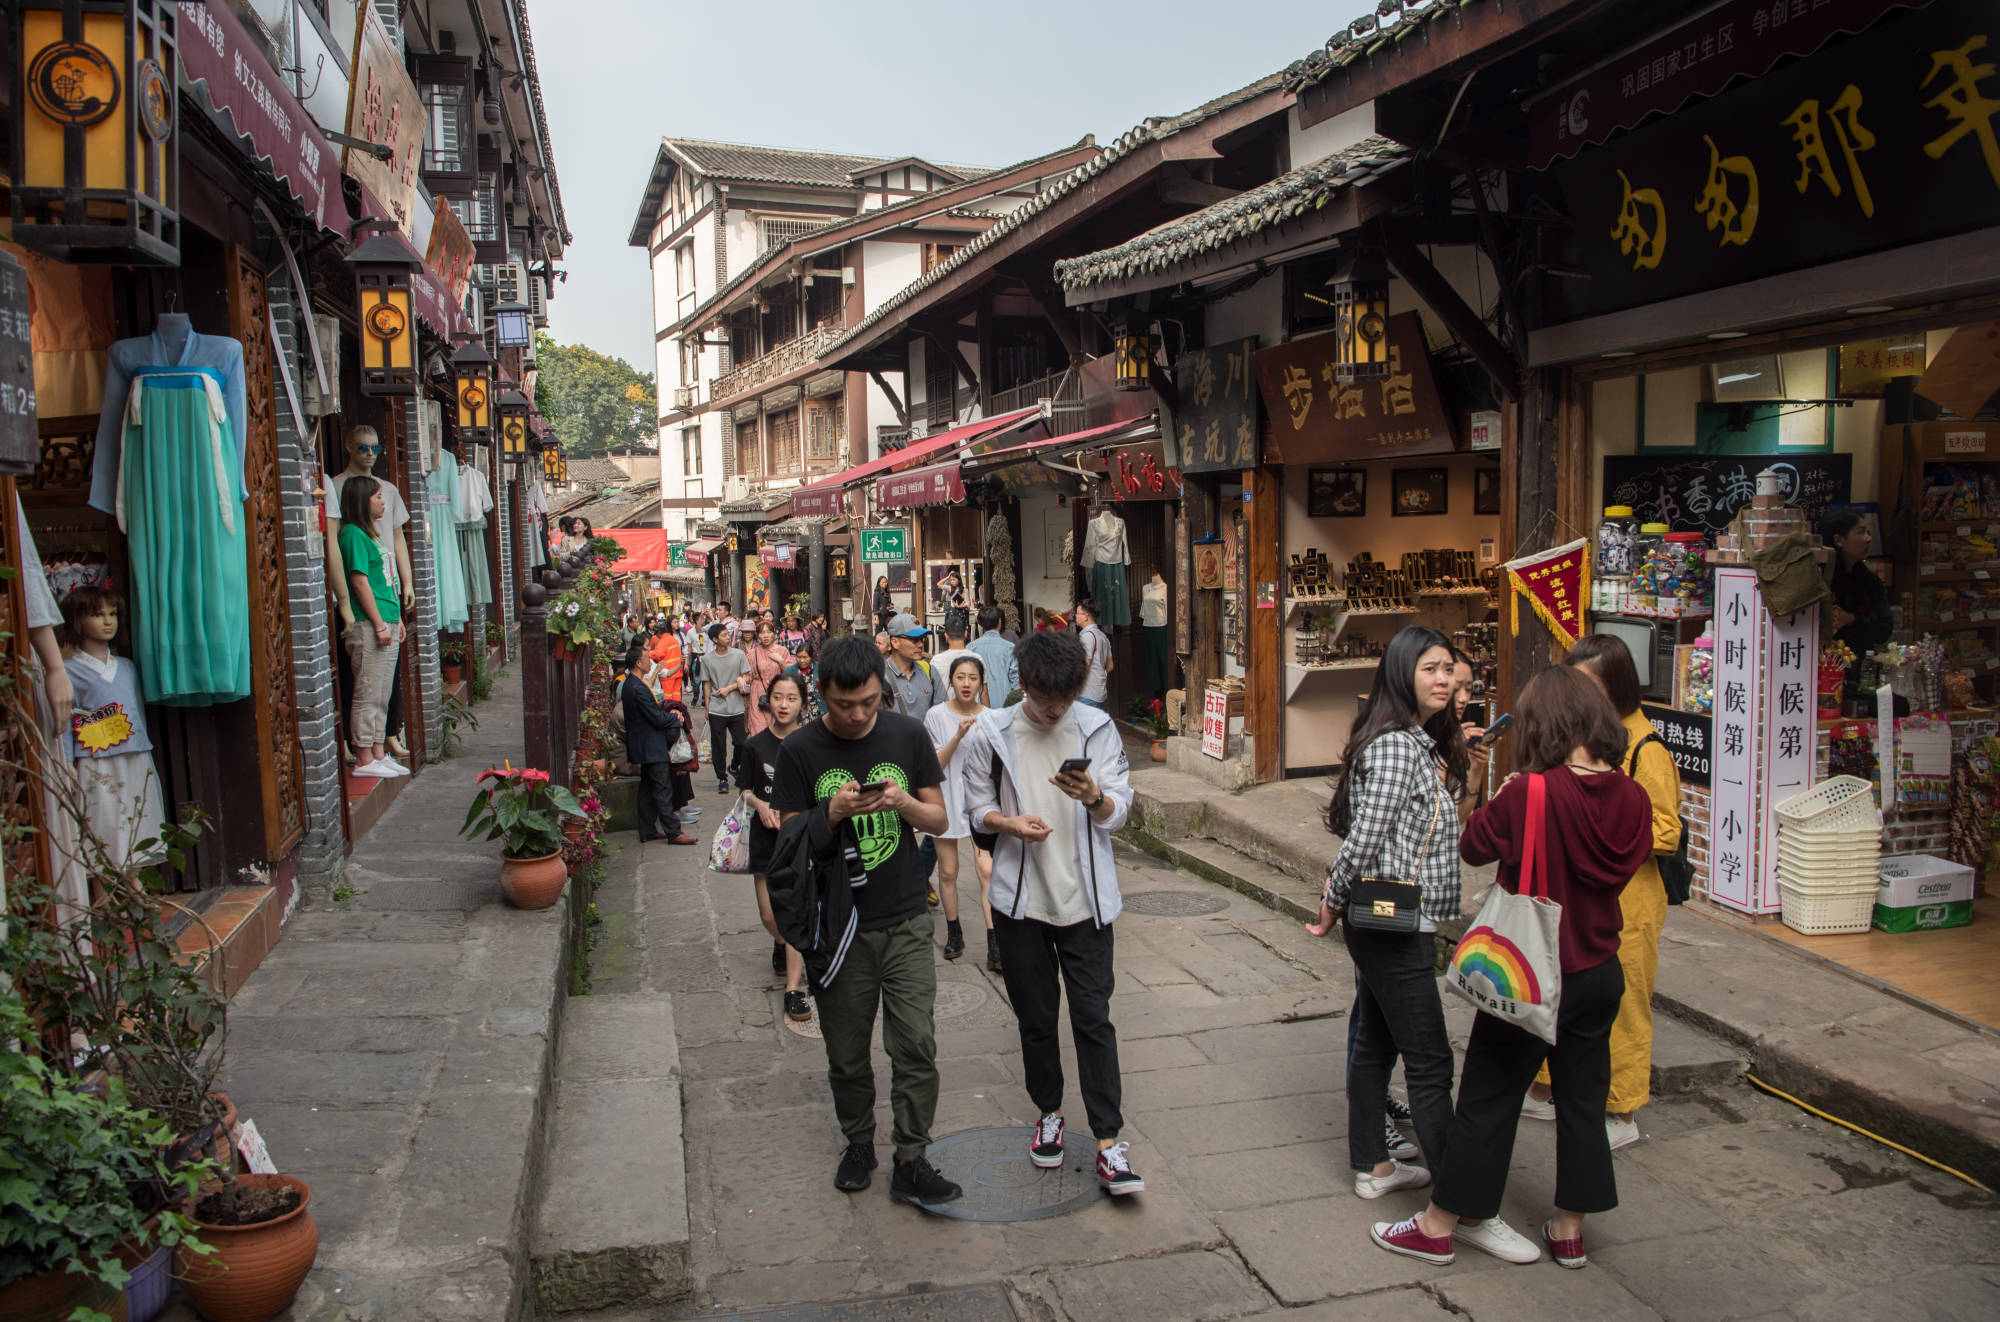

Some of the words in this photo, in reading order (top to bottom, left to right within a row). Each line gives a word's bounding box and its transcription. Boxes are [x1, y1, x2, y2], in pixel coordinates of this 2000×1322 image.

[1618, 22, 1736, 101] 巩固国家卫生区
[1609, 34, 2000, 272] 匆匆那年
[1853, 349, 1915, 369] 最美校园
[1527, 558, 1575, 582] 优秀班级
[1548, 577, 1576, 622] 流动红旗
[1205, 692, 1225, 716] 古玩
[1204, 715, 1224, 740] 收售
[1719, 591, 1750, 884] 小时候第一小学
[1458, 974, 1517, 1014] Hawaii
